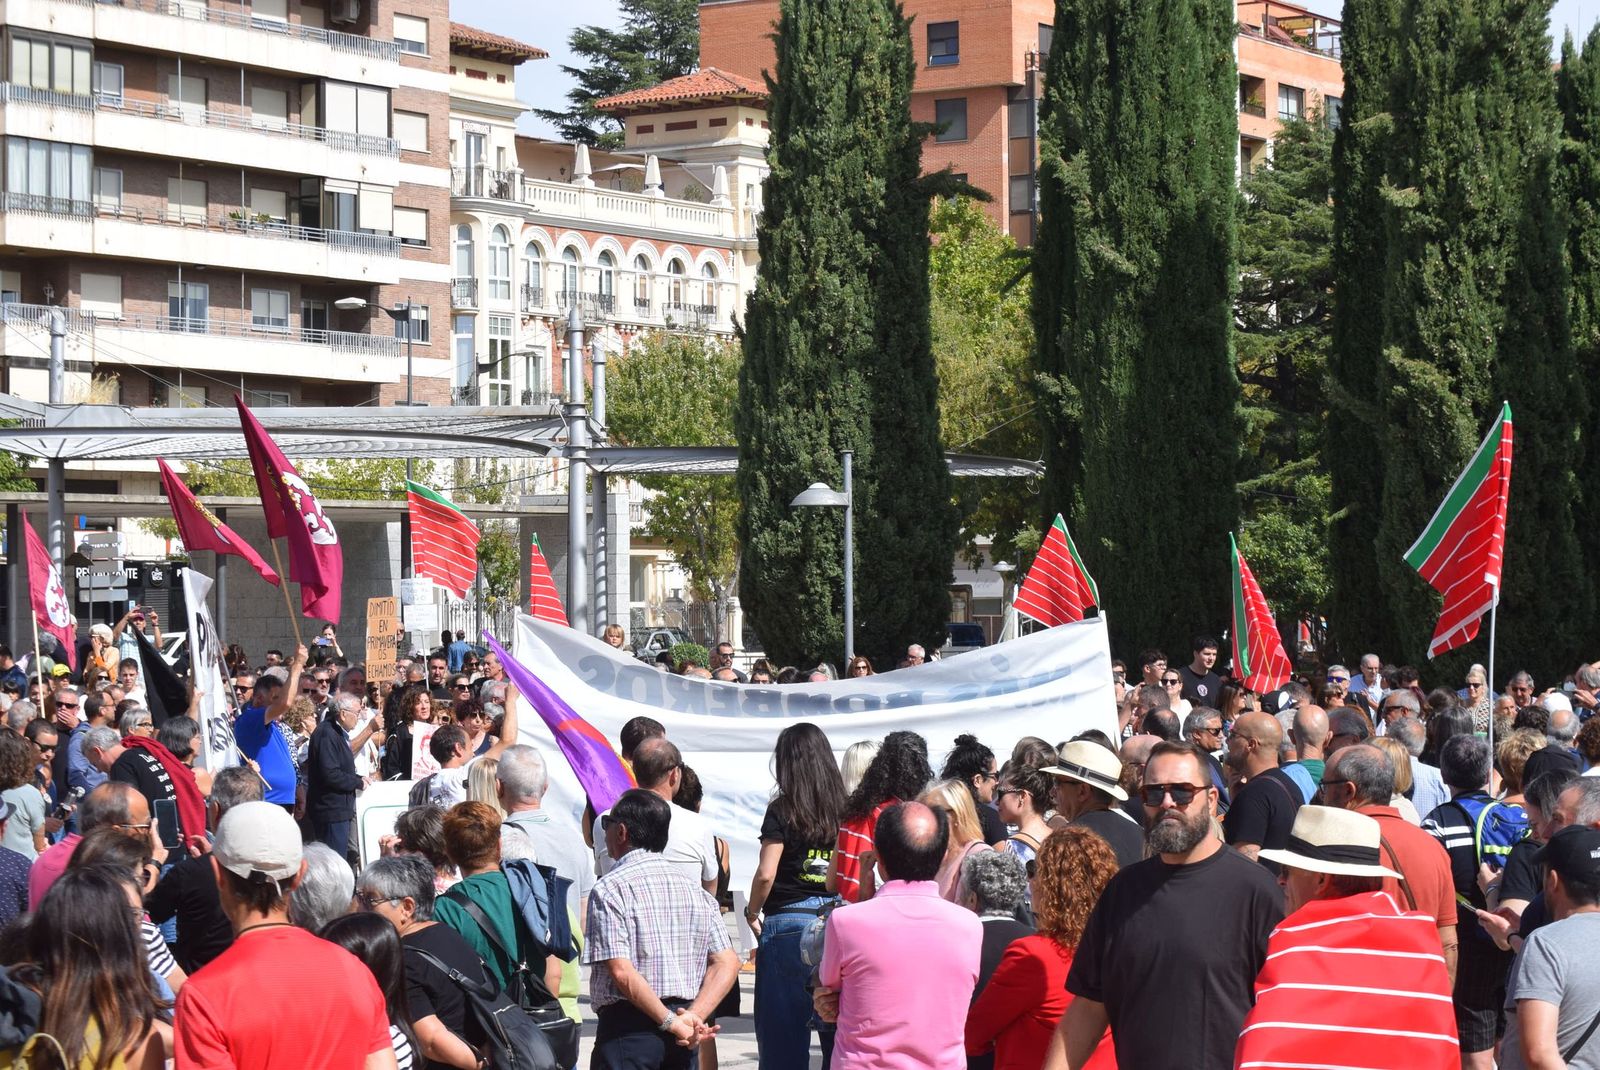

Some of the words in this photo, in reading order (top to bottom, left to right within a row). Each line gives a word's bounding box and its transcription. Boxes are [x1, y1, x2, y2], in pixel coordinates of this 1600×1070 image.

[379, 620, 388, 633] EN
[367, 635, 397, 649] PRIMAVERA
[378, 649, 387, 660] OS
[368, 663, 396, 679] ECHAMOS
